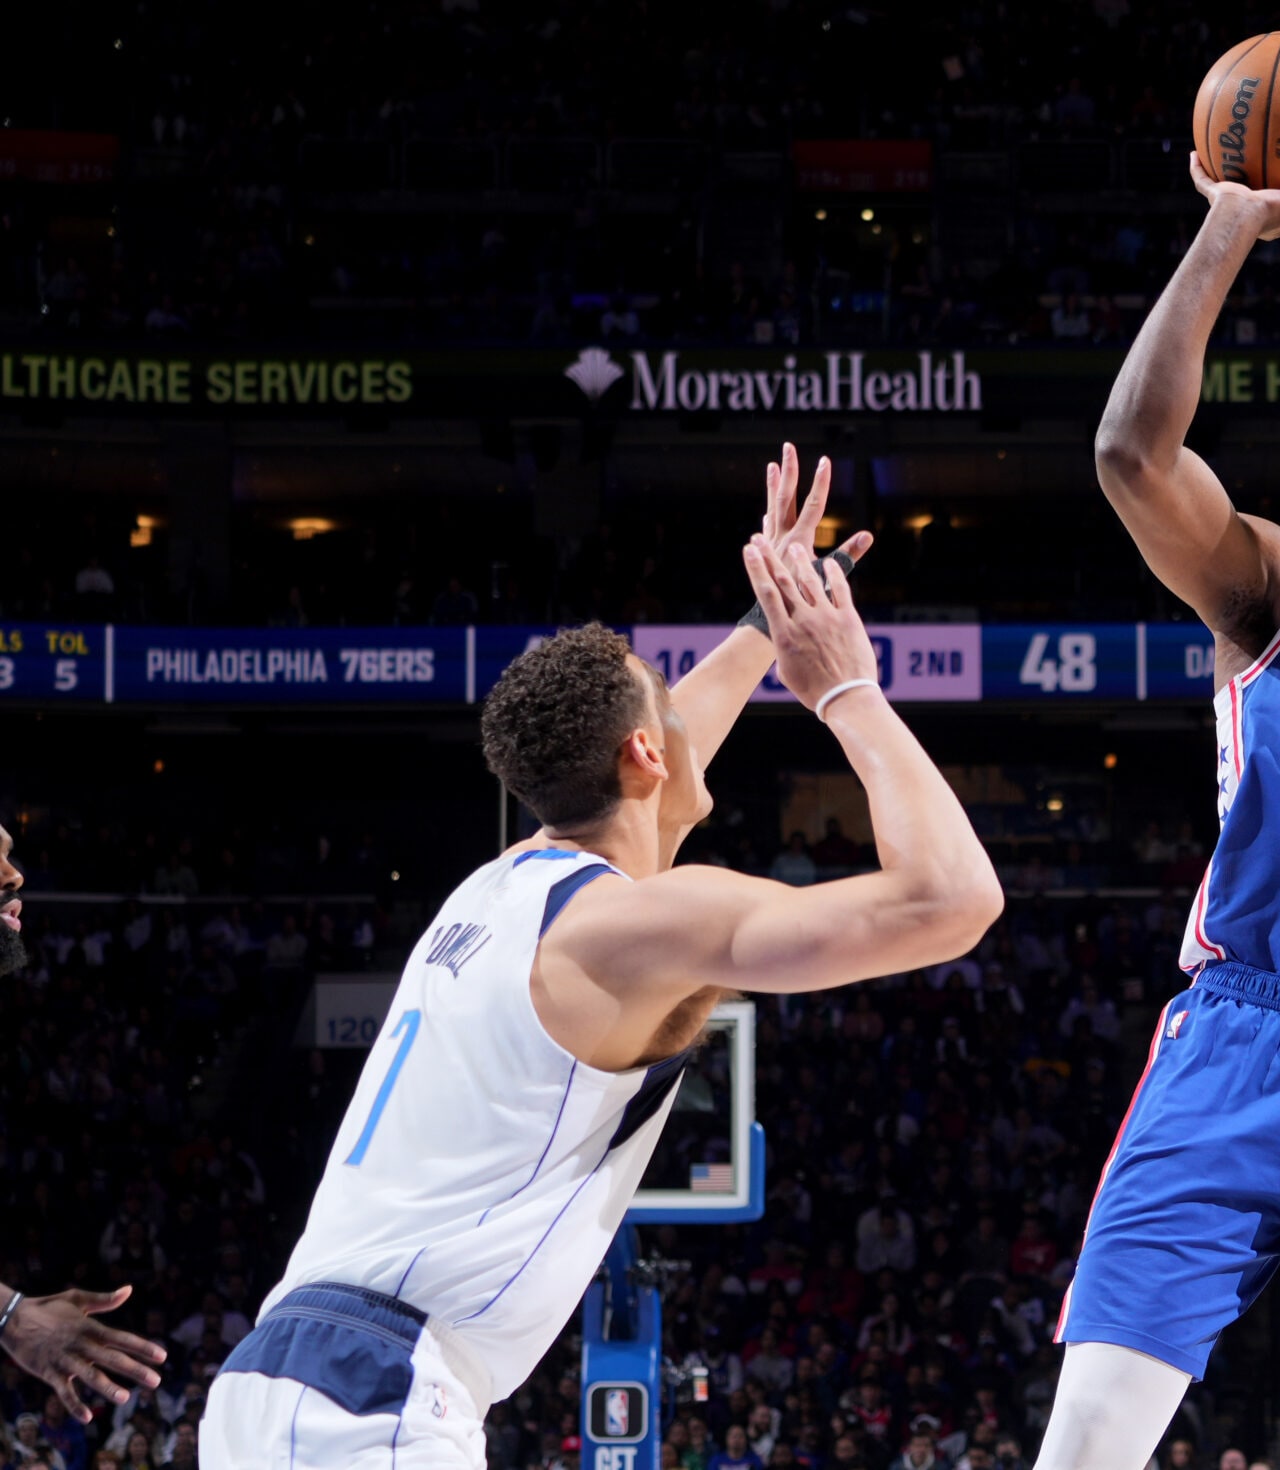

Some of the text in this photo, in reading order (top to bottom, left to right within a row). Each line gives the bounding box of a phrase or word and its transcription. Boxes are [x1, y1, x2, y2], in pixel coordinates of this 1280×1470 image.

[1, 355, 412, 403] LTHCARE SERVICES
[630, 351, 982, 410] MoraviaHealth
[46, 631, 88, 654] TOL
[55, 659, 78, 691] 5
[147, 648, 434, 682] PHILADELPHIA 76ERS
[909, 650, 963, 676] 2ND
[1019, 633, 1097, 692] 48
[328, 1016, 377, 1041] 120
